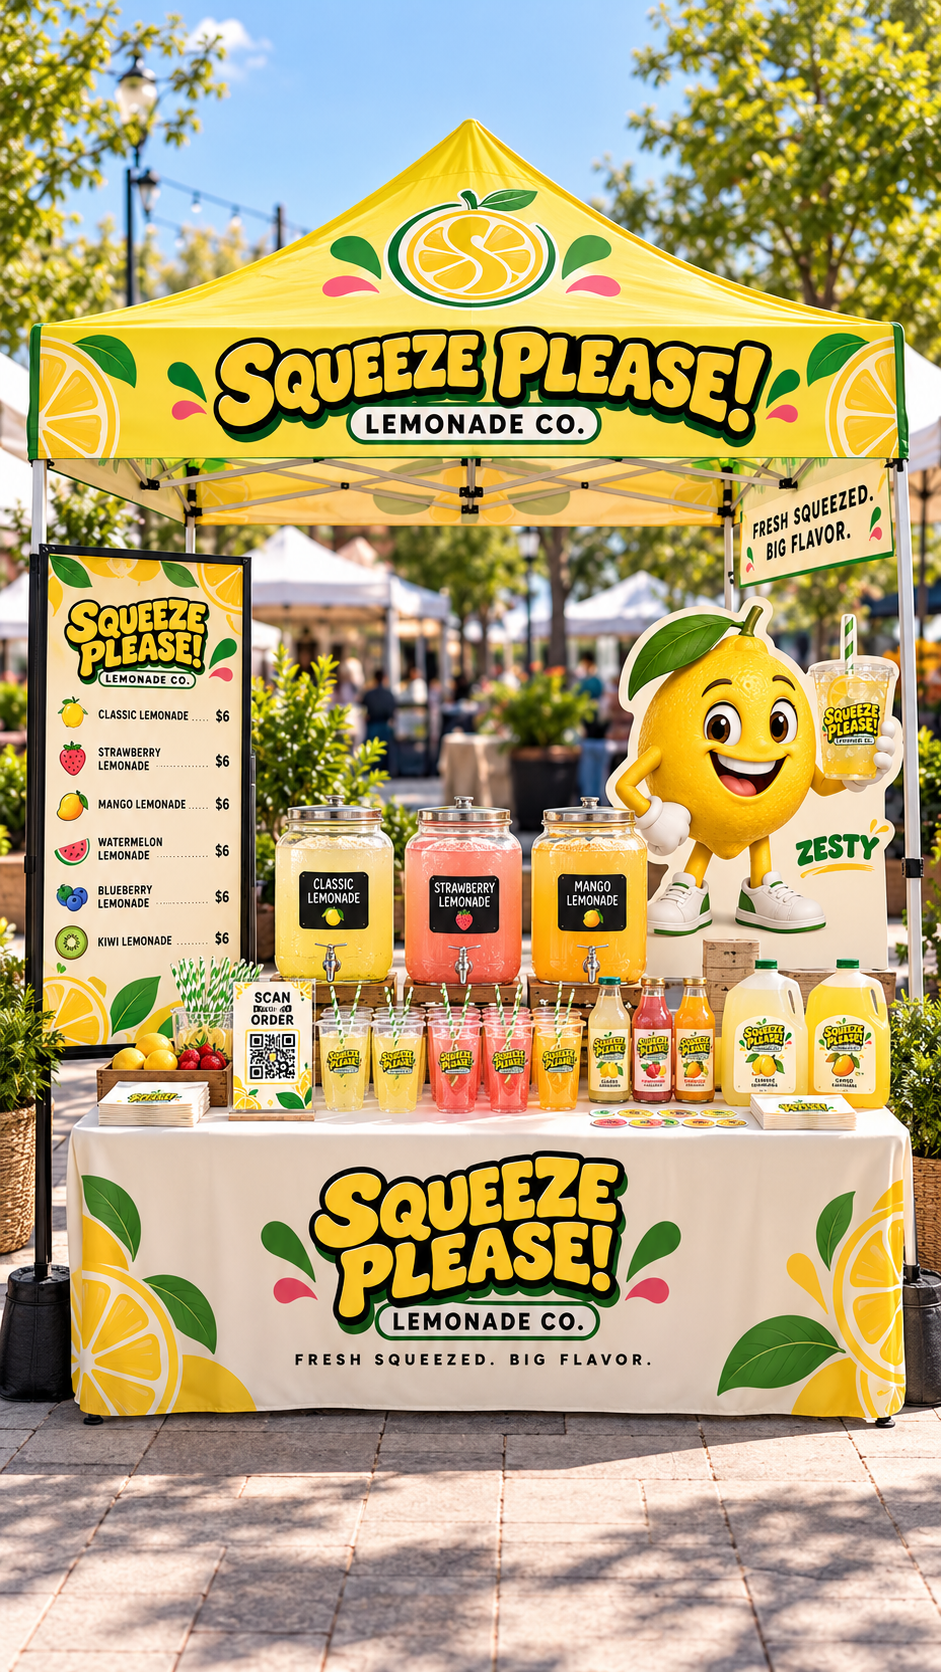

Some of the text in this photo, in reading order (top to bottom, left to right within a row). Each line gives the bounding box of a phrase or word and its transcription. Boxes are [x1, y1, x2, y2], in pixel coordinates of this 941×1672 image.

[215, 328, 768, 436] SQUEEZE PLEASE!
[365, 413, 584, 435] LEMONADE CO.
[752, 484, 874, 540] FRESH SQUEEZED.
[766, 520, 851, 561] BIG FLAVOR.
[65, 597, 207, 644] SQUEEZE
[79, 630, 204, 678] PLEASE!
[105, 673, 190, 685] LEMONADE CO.
[98, 709, 230, 723] CLASSIC LEMONADE $6
[824, 703, 879, 725] SQUEEZE
[827, 717, 878, 741] PLEASE!
[98, 747, 161, 758] STRAWBERRY
[98, 754, 230, 771] LEMONADE $6
[98, 797, 230, 811] MANGO LEMONADE $6
[98, 837, 163, 847] WATERMELON
[795, 833, 880, 867] ZESTY
[98, 844, 230, 861] LEMONADE $6
[98, 885, 153, 895] BLUEBERRY
[313, 877, 354, 890] CLASSIC
[434, 881, 496, 894] STRAWBERRY
[574, 880, 611, 893] MANGO
[98, 890, 230, 909] LEMONADE $6
[307, 892, 361, 904] LEMONADE
[438, 895, 491, 908] LEMONADE
[566, 894, 619, 906] LEMONADE
[97, 931, 229, 947] KIWI LEMONADE $6
[254, 991, 291, 1004] SCAN
[250, 1014, 294, 1026] ORDER
[312, 1154, 621, 1251] SQUEEZE
[336, 1220, 615, 1320] PLEASE!
[392, 1312, 584, 1331] LEMONADE CO.
[295, 1353, 652, 1367] FRESH SQUEEZED. BIG FLAVOR.
